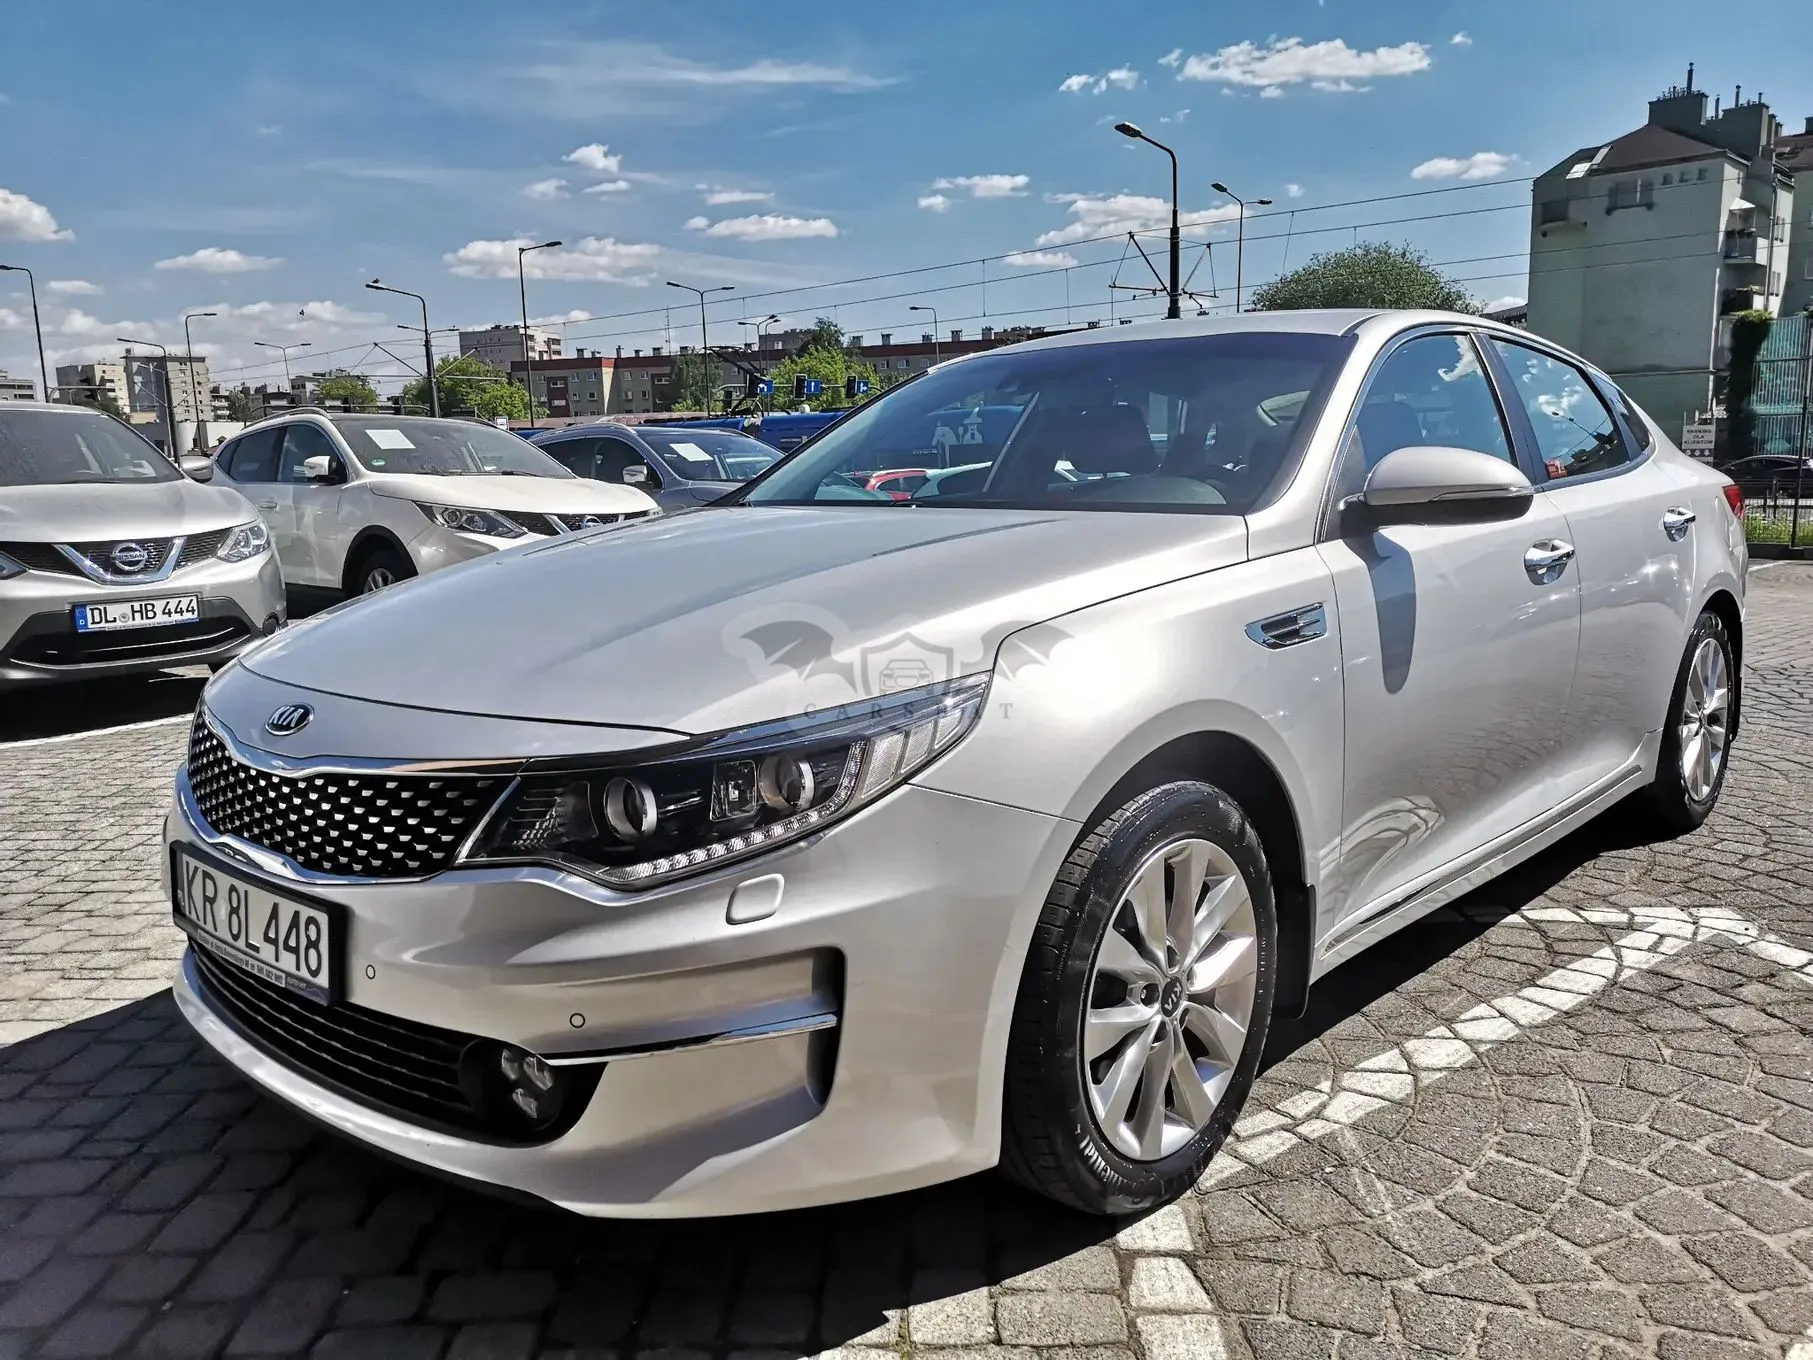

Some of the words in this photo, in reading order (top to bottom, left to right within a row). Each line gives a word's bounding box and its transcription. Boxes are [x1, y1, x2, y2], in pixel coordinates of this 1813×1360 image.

[89, 606, 117, 625] DL
[130, 602, 157, 622] HB
[161, 598, 196, 618] 444
[269, 706, 304, 728] KIA
[185, 860, 218, 933] KR
